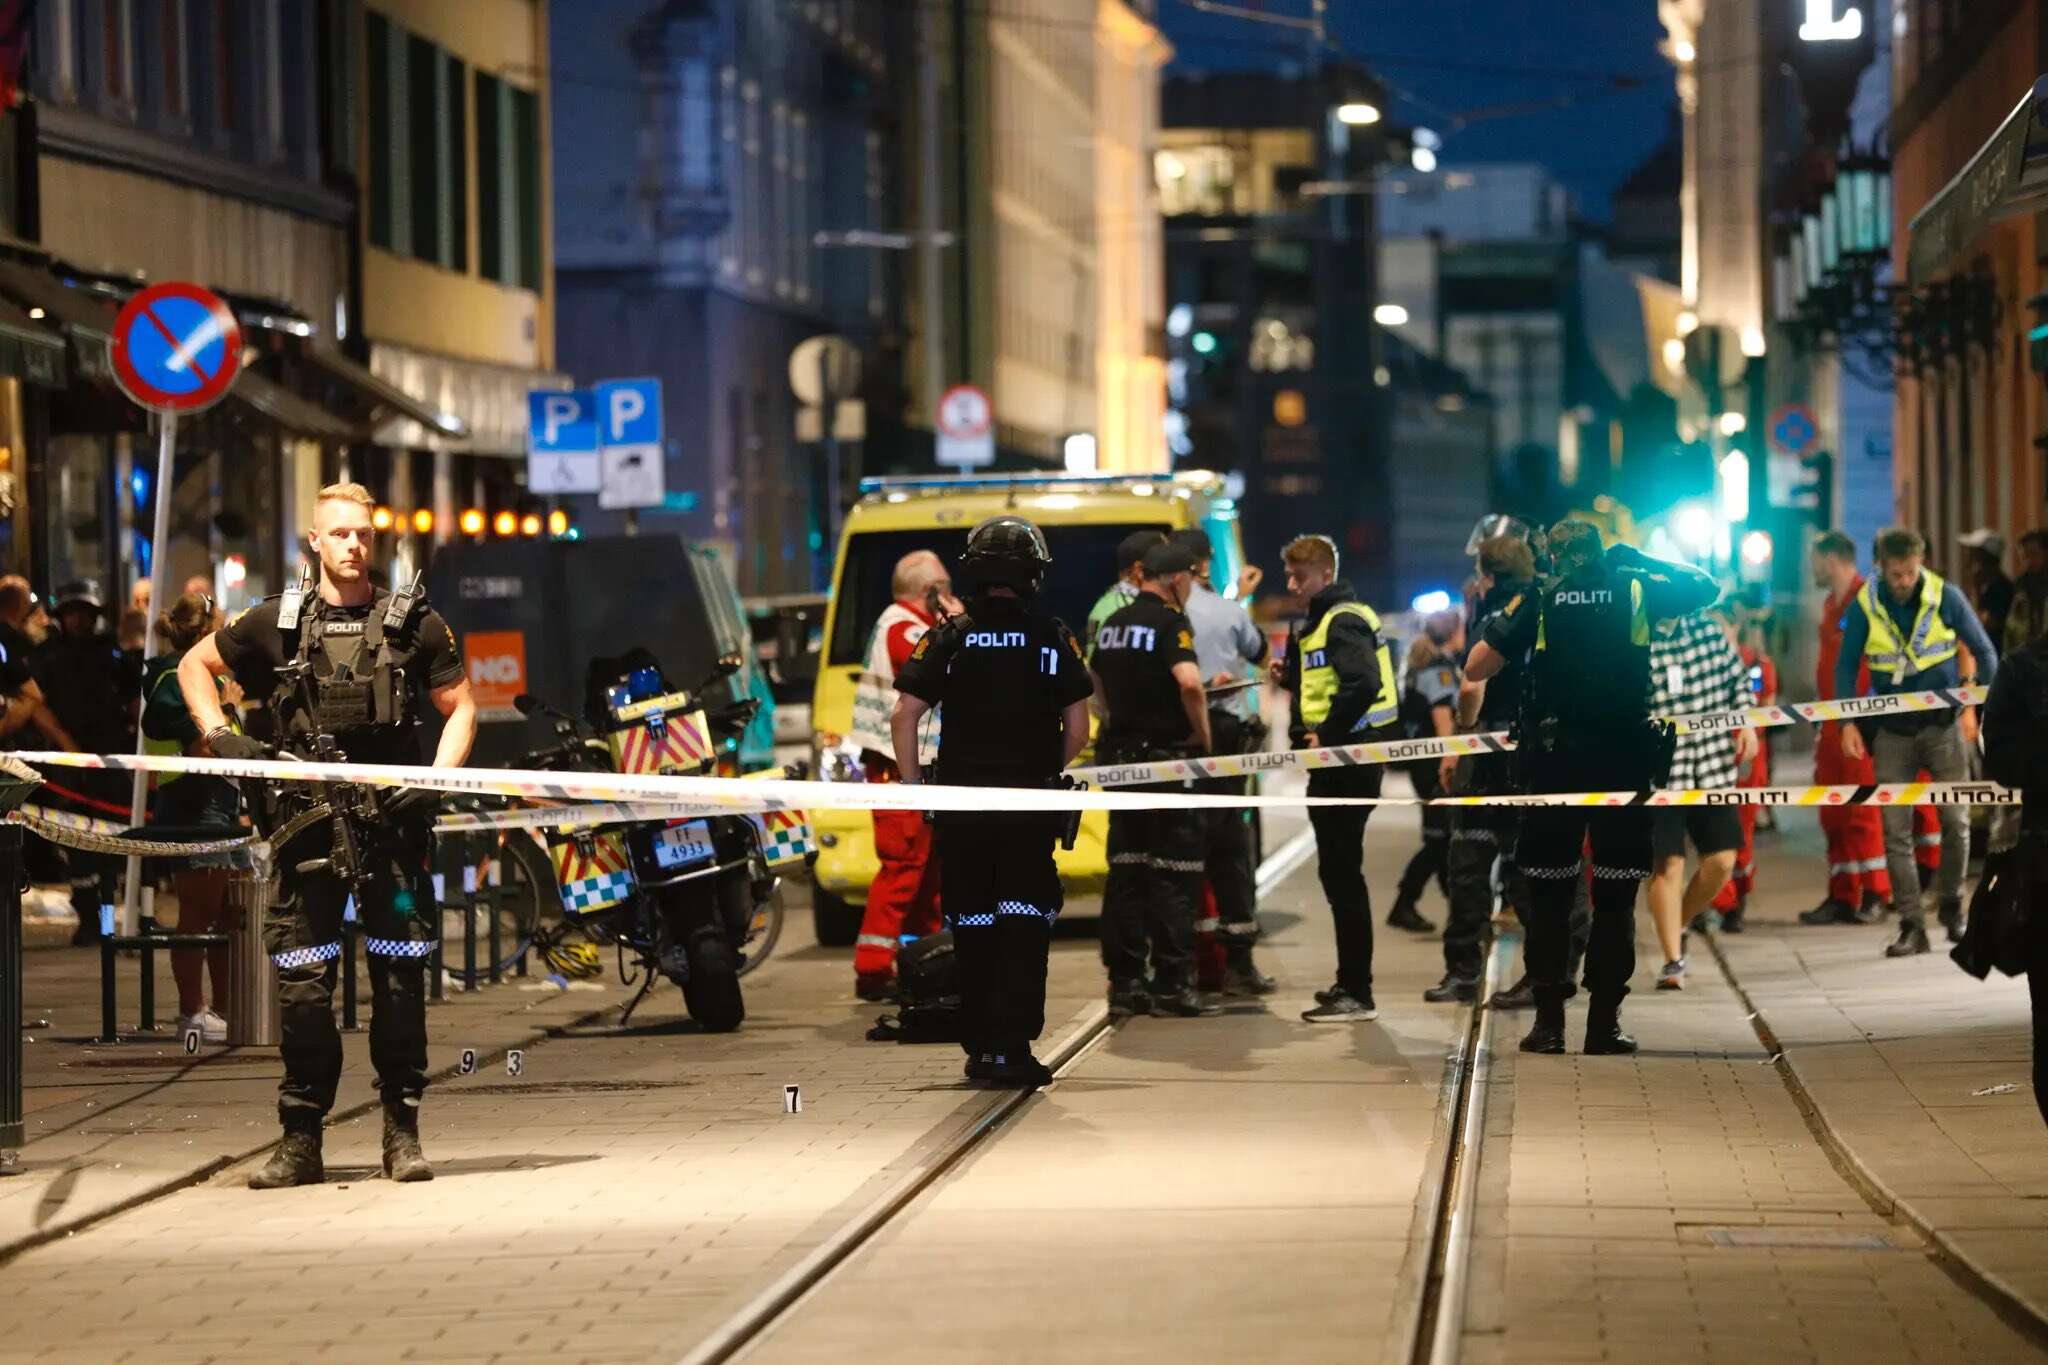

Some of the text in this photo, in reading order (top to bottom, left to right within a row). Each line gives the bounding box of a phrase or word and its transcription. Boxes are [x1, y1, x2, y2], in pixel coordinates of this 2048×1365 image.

[544, 396, 581, 445] P
[611, 389, 645, 441] P
[1555, 590, 1612, 605] POLITI
[326, 622, 362, 632] POLITI
[1098, 624, 1155, 651] OLITI
[965, 632, 1025, 648] POLITI
[671, 840, 704, 859] 4933
[186, 1031, 198, 1054] 0
[462, 1050, 474, 1073] 9
[508, 1051, 520, 1076] 3
[785, 1086, 799, 1114] 7
